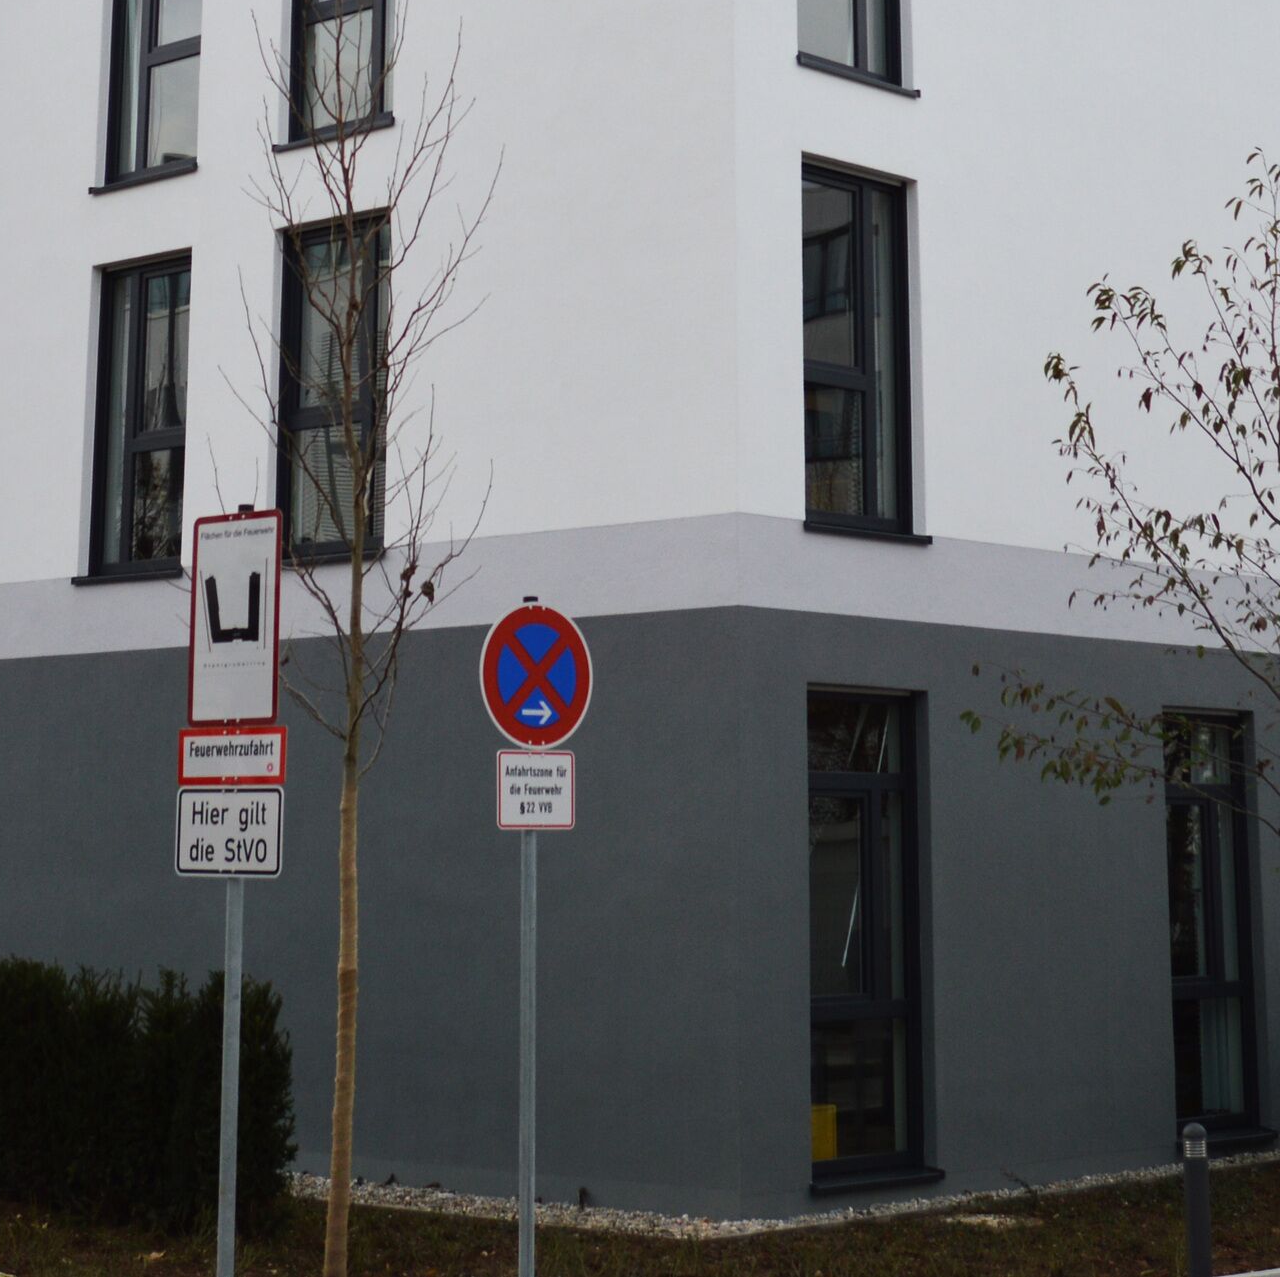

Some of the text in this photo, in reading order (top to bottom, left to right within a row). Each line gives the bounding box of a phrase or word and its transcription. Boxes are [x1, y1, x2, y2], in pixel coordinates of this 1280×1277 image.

[189, 740, 273, 758] Feuerwehrzufahrt
[505, 765, 567, 777] Anfahrtszone für
[509, 784, 562, 795] die Feuerwehr
[192, 801, 267, 832] Hier gilt
[189, 838, 267, 863] die StVO
